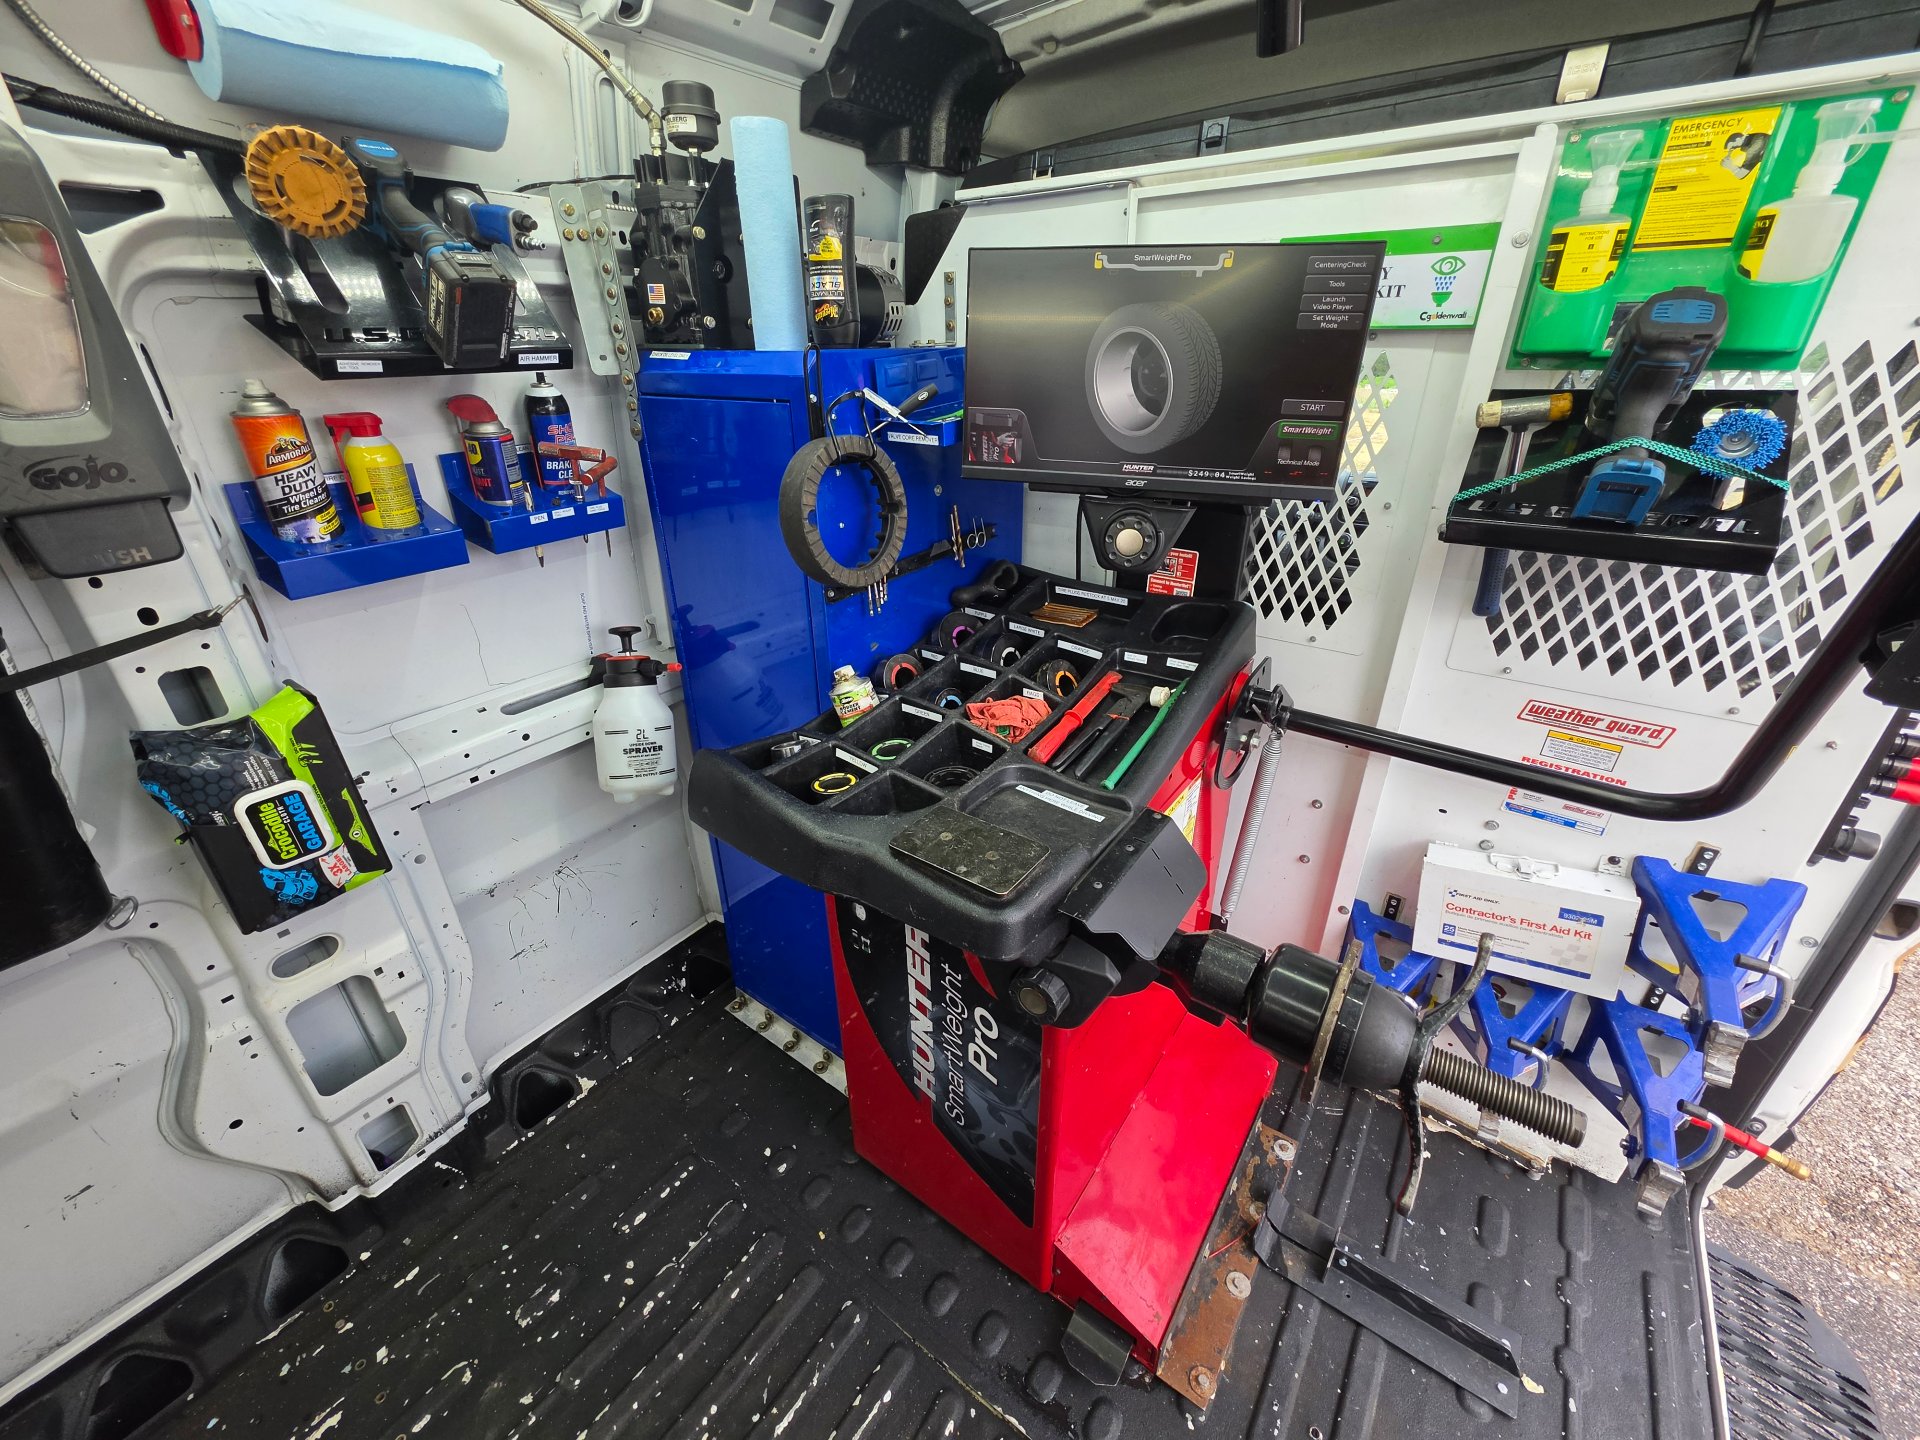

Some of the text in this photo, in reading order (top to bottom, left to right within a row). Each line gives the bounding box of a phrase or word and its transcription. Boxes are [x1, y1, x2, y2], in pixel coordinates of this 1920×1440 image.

[1673, 117, 1744, 134] EMERGENCY
[1134, 254, 1178, 262] SmartWeight
[1314, 261, 1367, 269] CenteringCheck
[1332, 303, 1354, 311] Player
[1325, 314, 1349, 322] Weight
[531, 354, 558, 362] HAMMER
[1300, 403, 1325, 412] START
[1282, 425, 1331, 435] SmartWeight
[546, 460, 572, 470] BRAK
[1277, 458, 1302, 466] Technical
[29, 455, 129, 491] GOJO
[273, 463, 317, 487] HEAVY
[281, 476, 317, 497] DUTY
[1125, 479, 1147, 487] acer
[289, 485, 323, 504] Wheel &
[282, 493, 327, 514] Tire Cleaner
[1545, 505, 1762, 536] GERAL
[1013, 624, 1027, 632] LARGE
[1071, 645, 1090, 655] ORANGE
[1026, 690, 1040, 698] RAGS
[914, 708, 930, 717] GREEN
[1528, 704, 1667, 740] weather guard
[635, 728, 649, 740] 2L
[1576, 737, 1601, 746] CAUTION
[622, 744, 663, 756] SPRAYER
[849, 756, 868, 768] YELLOW
[1520, 755, 1628, 787] REGISTRATION
[277, 807, 291, 824] CLOTH
[283, 793, 322, 851] GARAGE
[258, 802, 299, 860] Crocodile
[328, 861, 342, 877] 3X
[334, 853, 353, 878] LARGER
[1446, 902, 1593, 941] Contractor's First Aid Kit
[904, 923, 937, 1102] HUNTER
[941, 962, 969, 1126] SmartWeight
[968, 1006, 999, 1086] Pro
